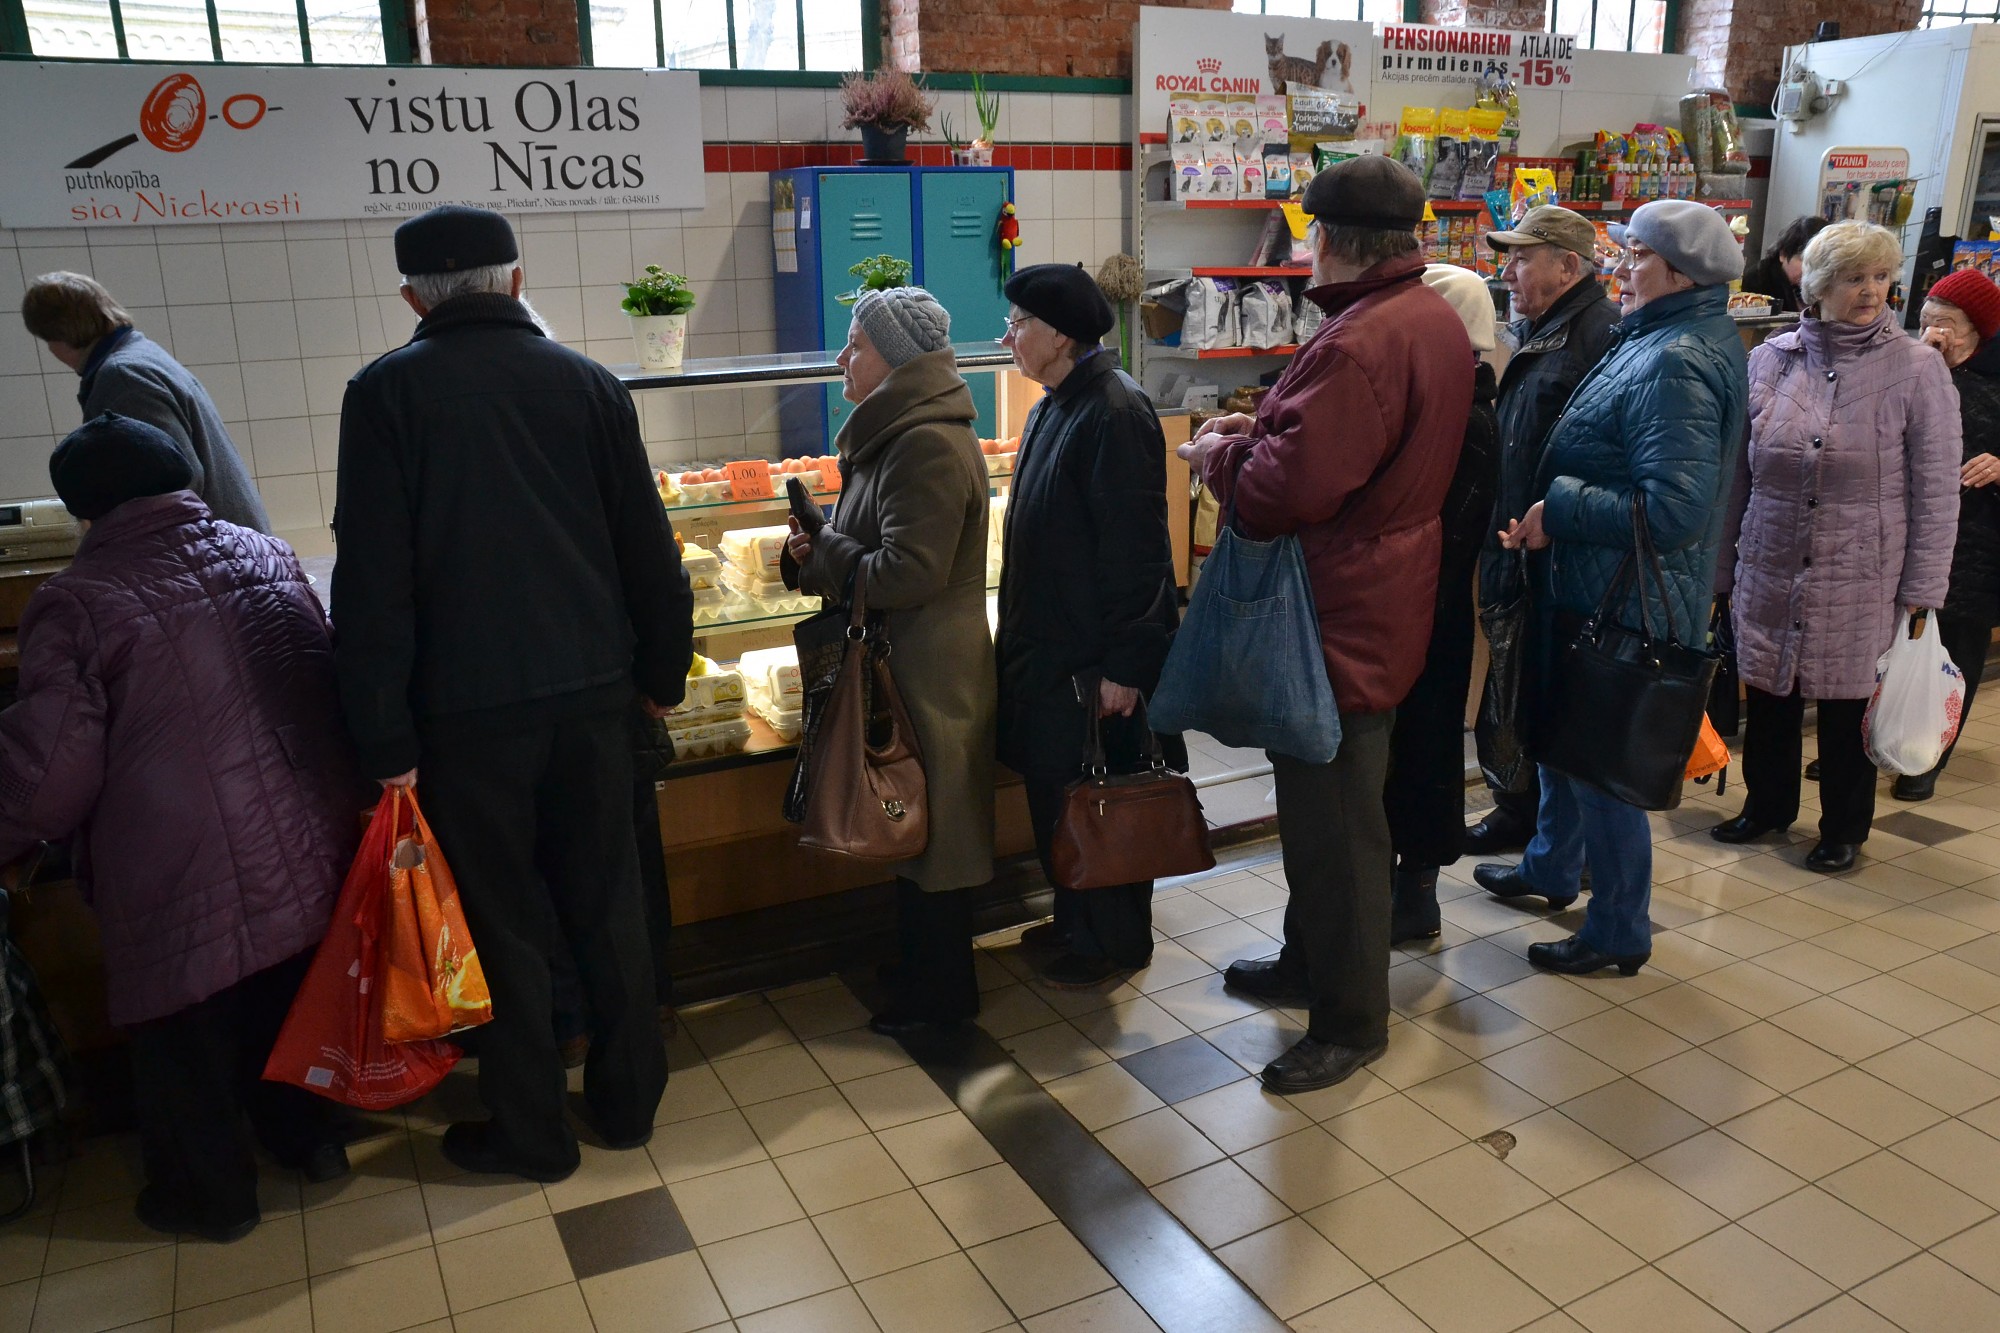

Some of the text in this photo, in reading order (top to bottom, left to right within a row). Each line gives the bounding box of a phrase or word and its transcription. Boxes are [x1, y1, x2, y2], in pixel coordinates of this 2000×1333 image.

[1383, 27, 1574, 60] PENSIONARIEM ATLAIDE
[1381, 71, 1410, 83] Akcijas
[1411, 72, 1440, 82] precēm
[1382, 53, 1571, 86] pirmdienās -15%
[1156, 74, 1260, 94] ROYAL CANIN
[344, 78, 641, 134] vistu Olas
[365, 141, 645, 195] no Nīcas
[1830, 156, 1864, 167] TITANIA
[64, 170, 161, 193] putnkopība
[71, 189, 302, 222] sia Nickrasti
[621, 194, 660, 204] 63486115
[732, 468, 757, 480] 1.00
